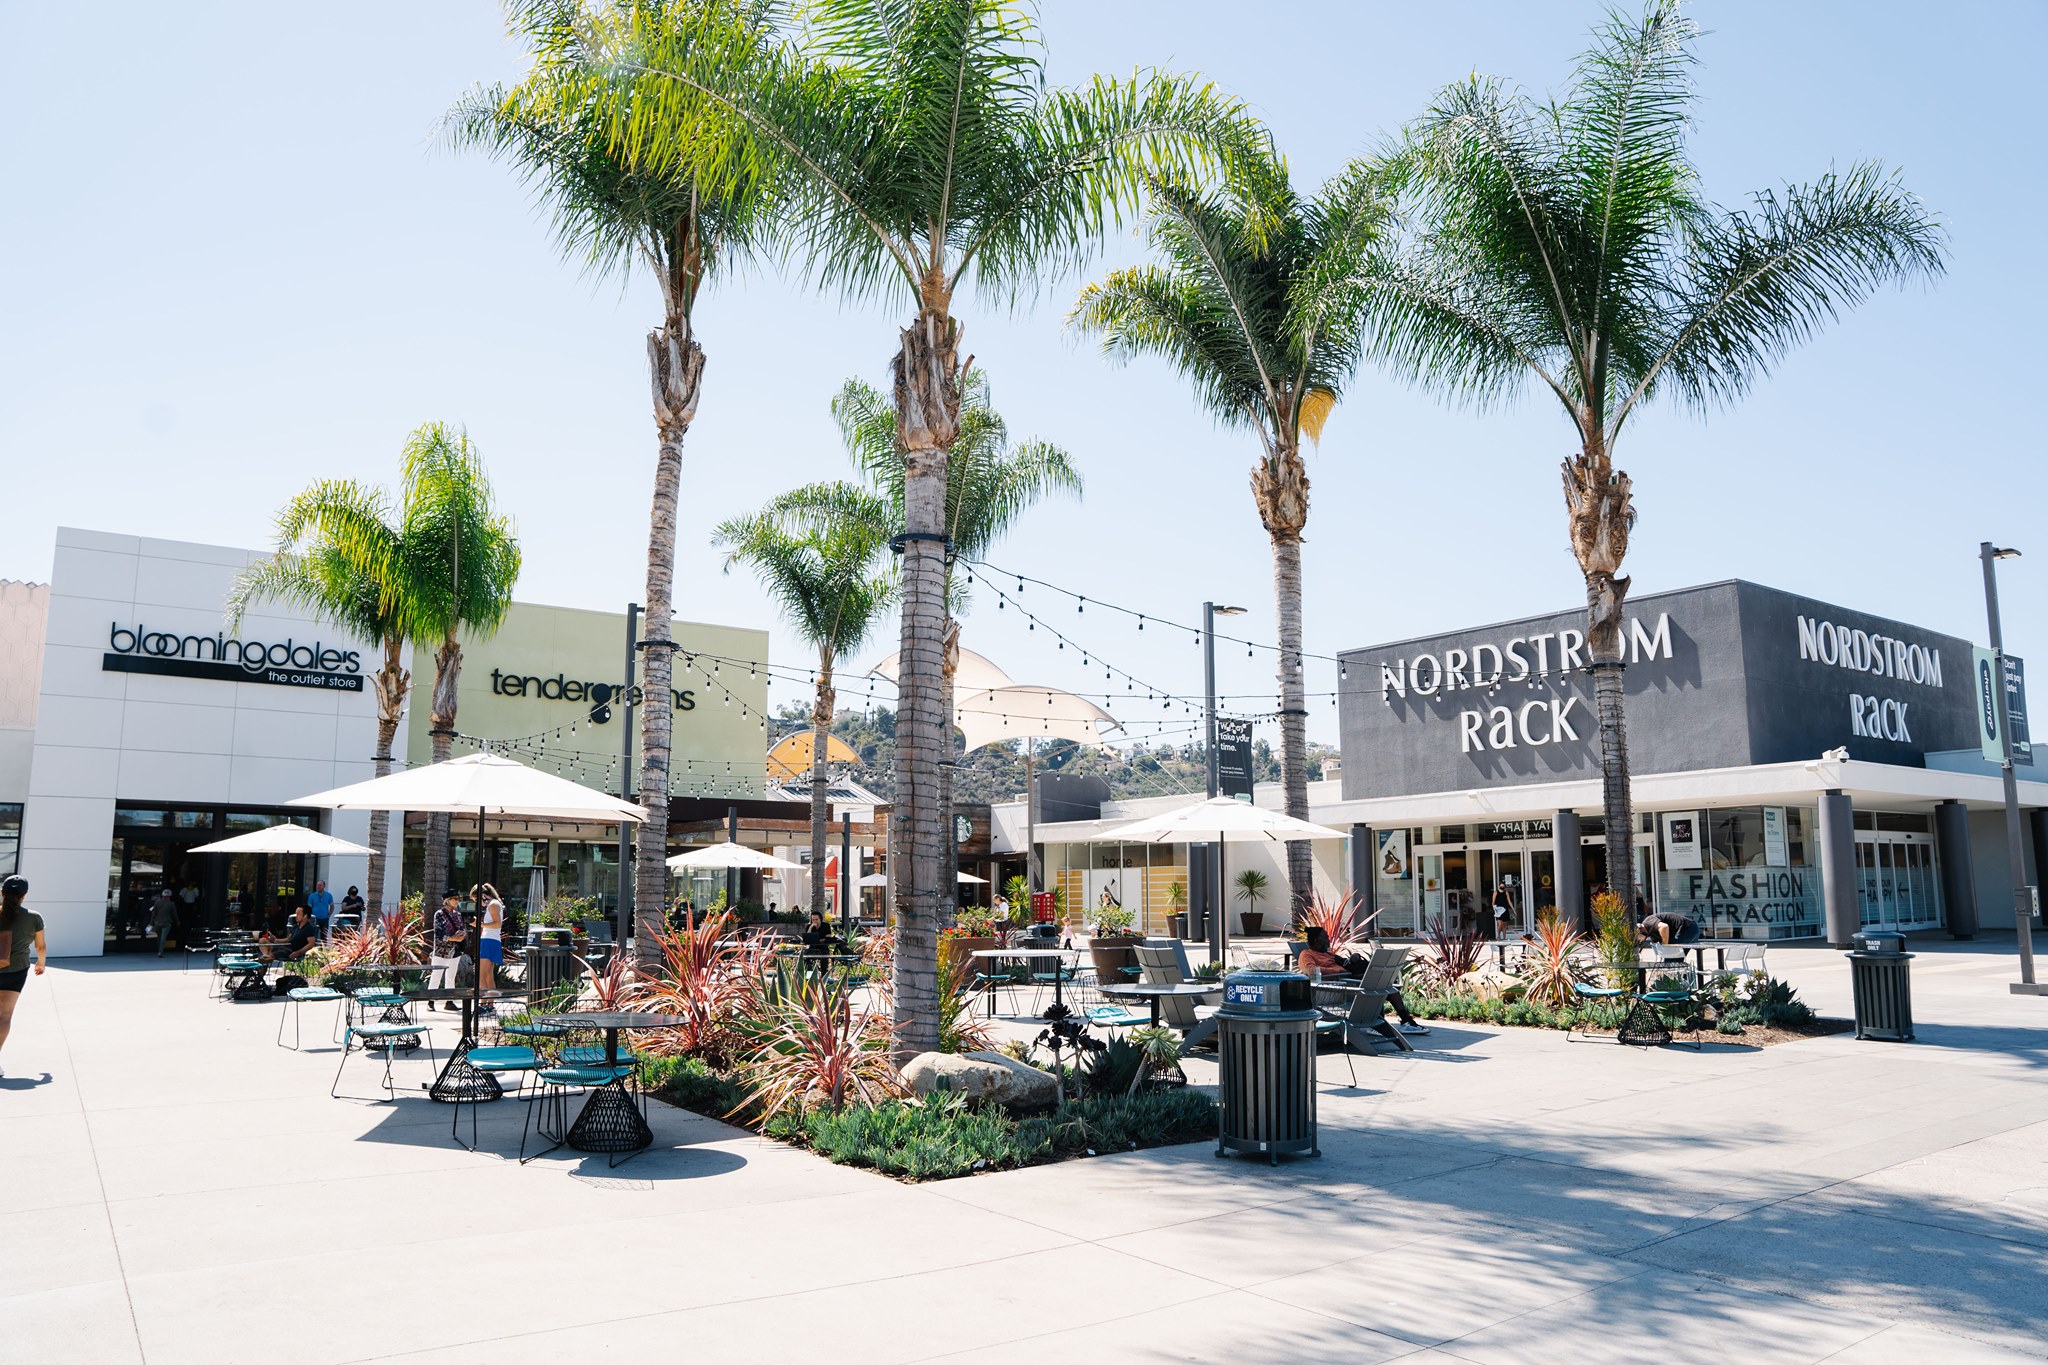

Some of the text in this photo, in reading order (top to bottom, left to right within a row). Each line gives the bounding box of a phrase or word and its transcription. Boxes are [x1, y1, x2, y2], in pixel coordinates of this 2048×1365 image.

[110, 621, 361, 674] bloomingdale's
[1797, 615, 1943, 688] NORDSTROM
[1382, 613, 1673, 701] NORDSTRM
[268, 671, 357, 688] the outlet store
[491, 668, 696, 724] tendergrens
[1220, 732, 1251, 744] take your
[1220, 742, 1237, 752] time.
[1102, 855, 1133, 868] home
[1690, 872, 1803, 899] FASHION
[1692, 904, 1705, 913] AT
[1713, 902, 1805, 923] FRACTION
[1235, 985, 1263, 994] RECYCLE
[1240, 994, 1257, 1002] ONLY
